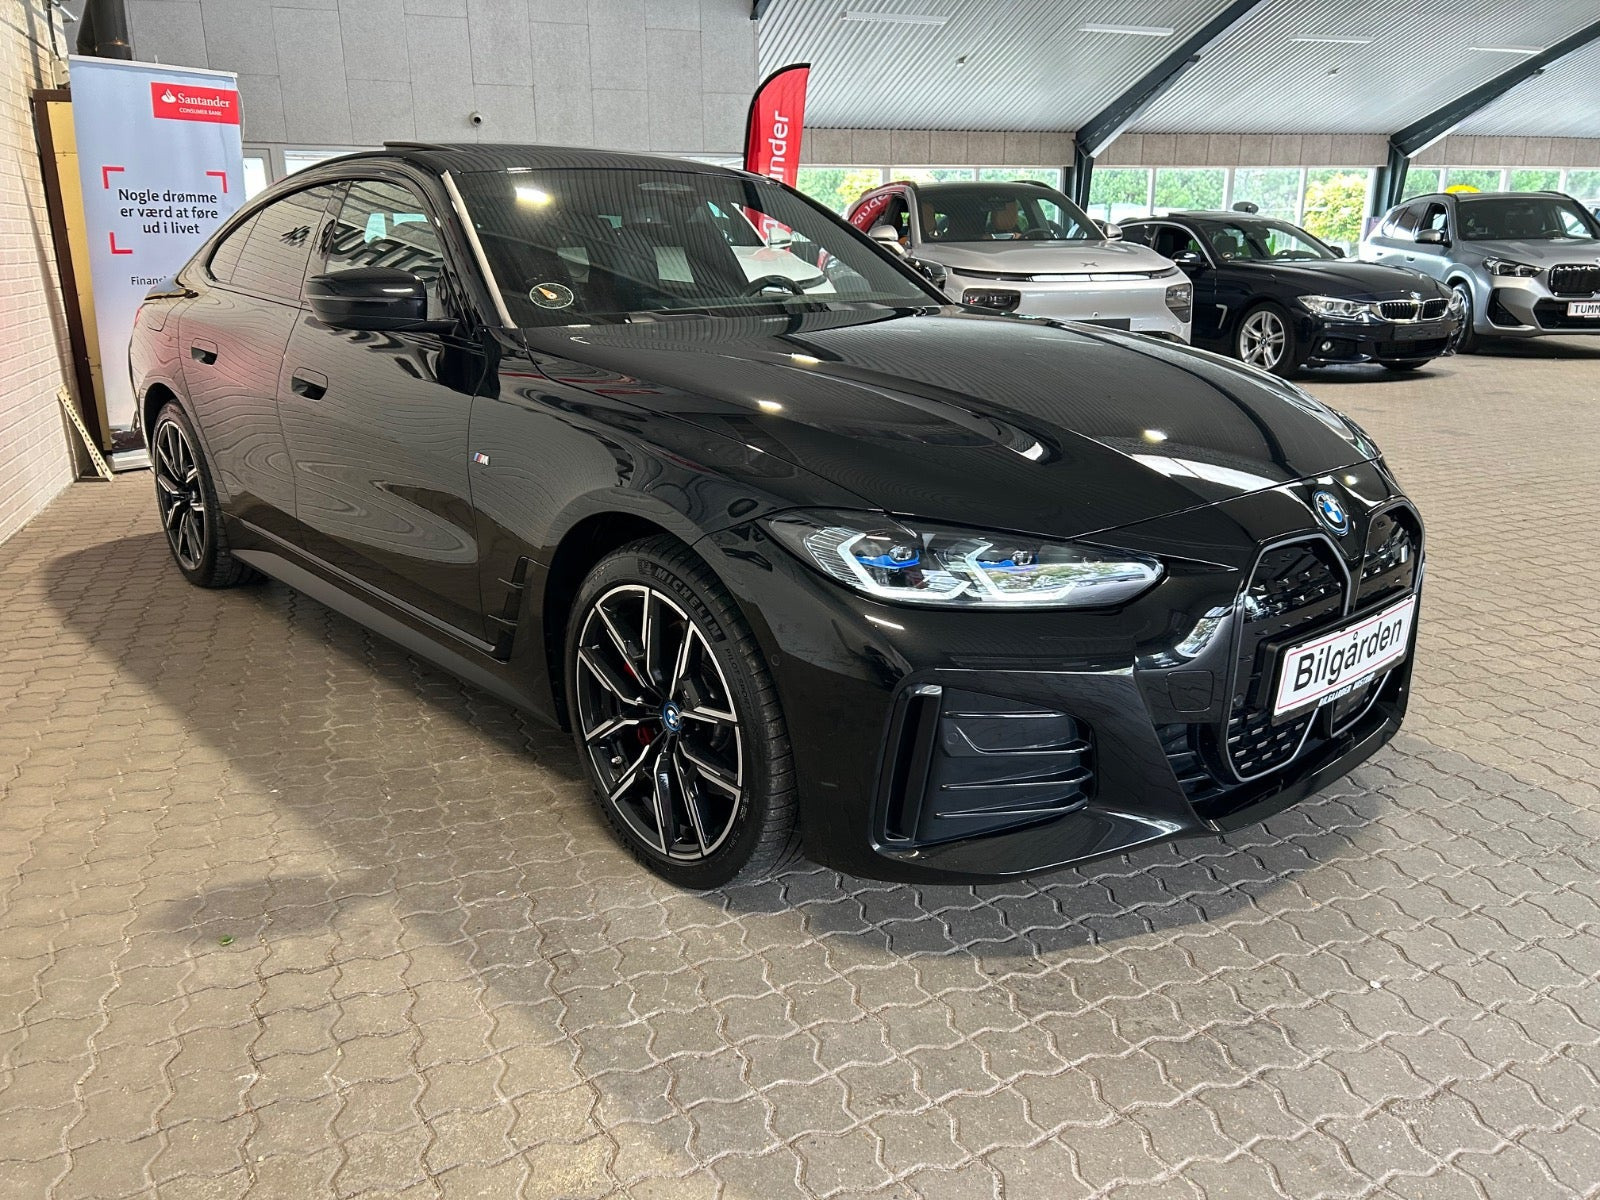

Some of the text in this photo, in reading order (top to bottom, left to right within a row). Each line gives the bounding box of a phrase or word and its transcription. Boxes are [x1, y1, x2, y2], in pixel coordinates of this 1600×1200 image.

[177, 92, 231, 108] Santander
[118, 188, 217, 205] Nogle drømme
[120, 206, 219, 219] er værd at føre
[143, 221, 200, 234] ud i livet
[655, 568, 722, 642] MICHELIN
[1293, 618, 1403, 691] Bilgården
